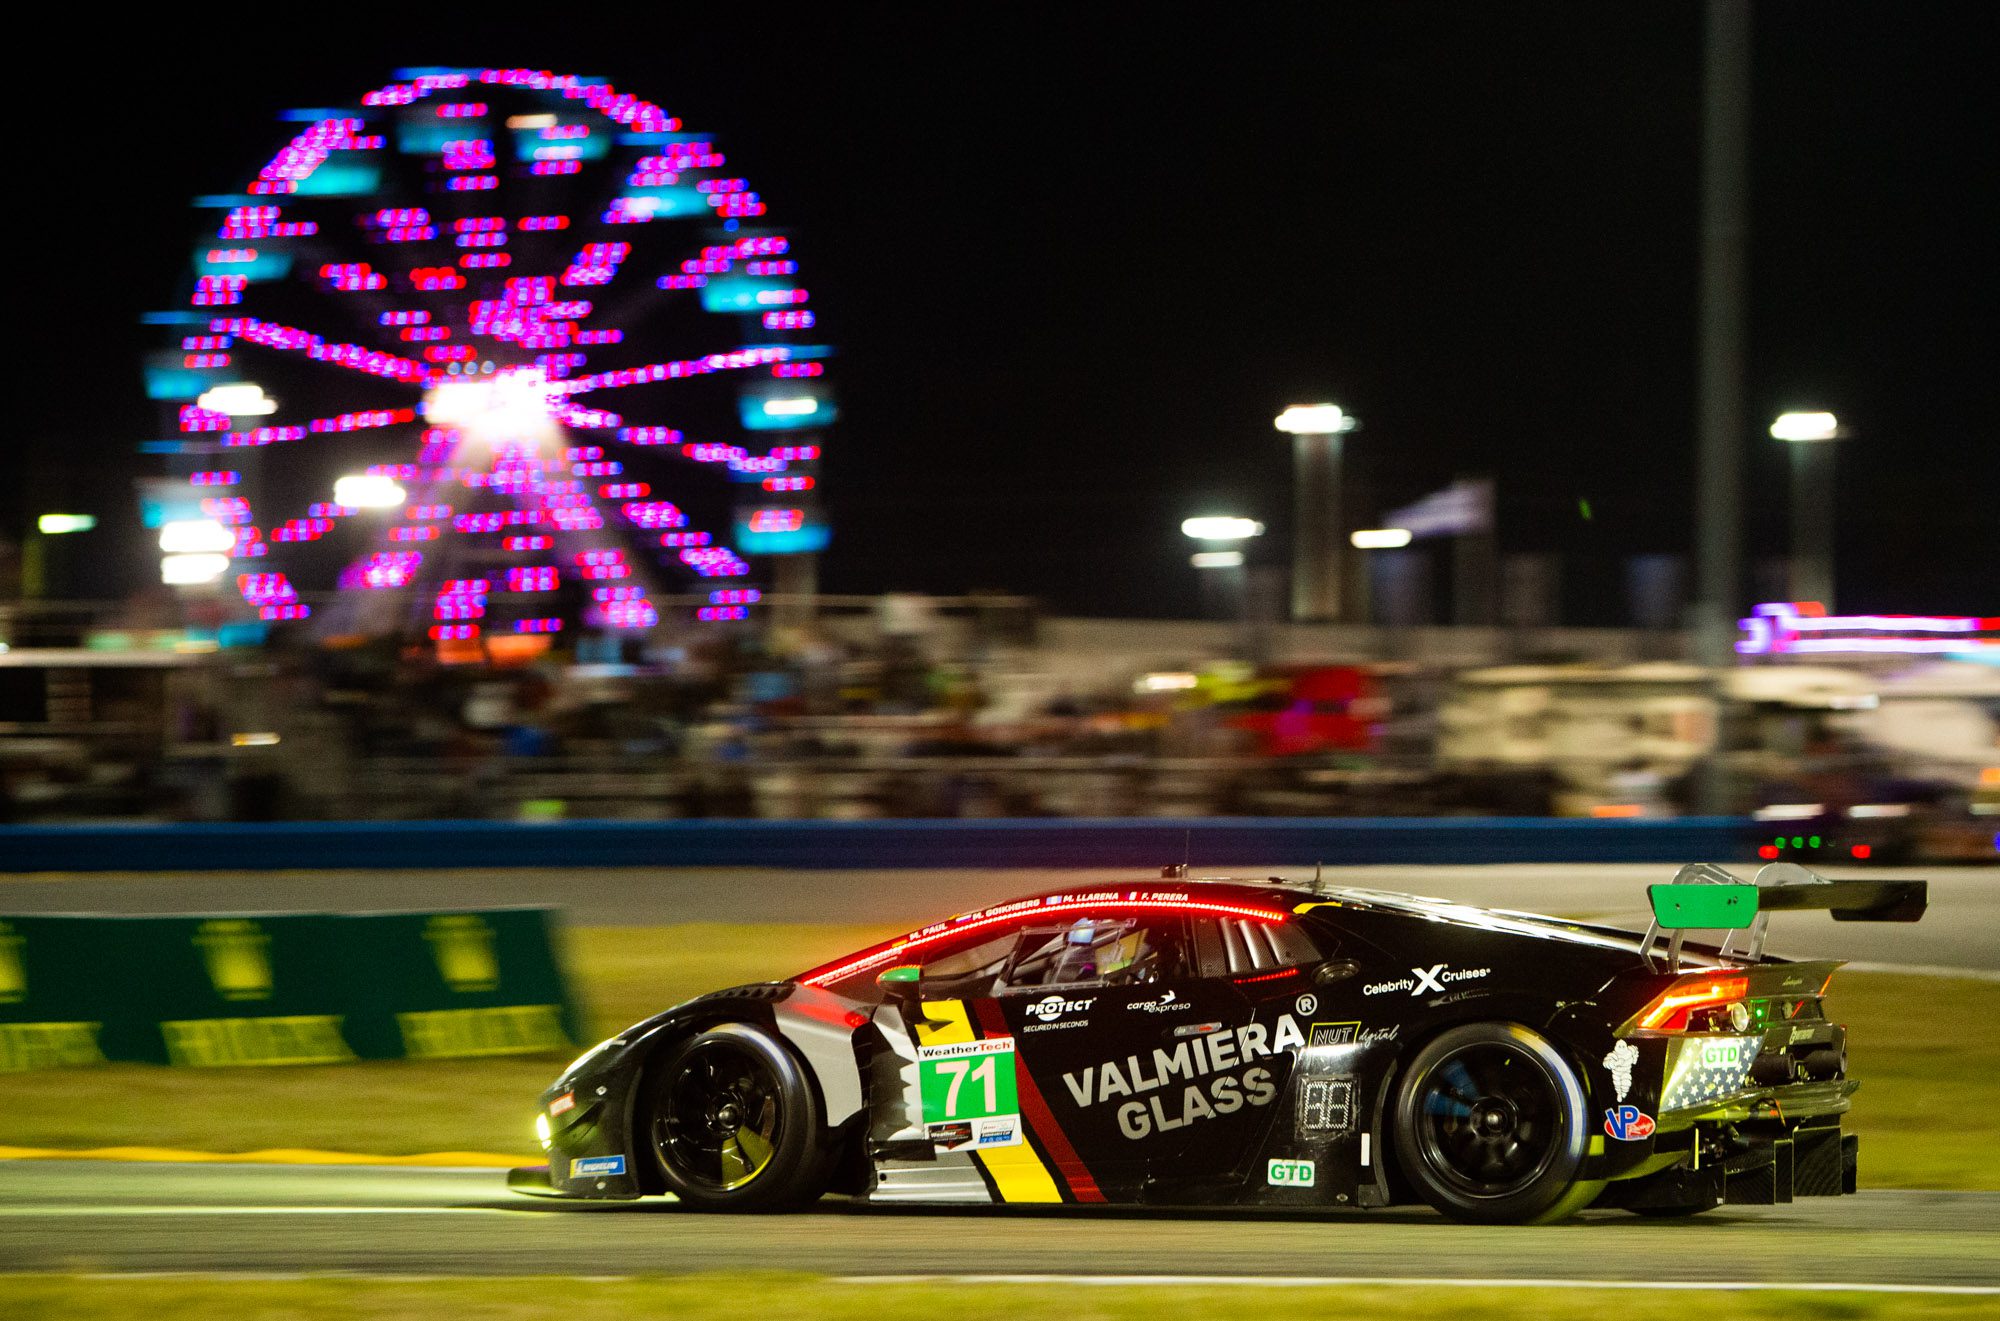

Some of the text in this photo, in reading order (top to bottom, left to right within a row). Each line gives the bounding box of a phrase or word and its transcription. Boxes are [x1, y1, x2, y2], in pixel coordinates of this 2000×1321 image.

[1062, 892, 1119, 903] M. LLARENA
[1151, 892, 1189, 901] PERERA
[922, 922, 948, 936] PAUL
[1363, 979, 1415, 996] Celebrity
[1441, 968, 1488, 982] Cruises
[1025, 999, 1094, 1016] PROTECT
[1127, 1000, 1191, 1014] cargo expreso
[1023, 1024, 1052, 1033] SECURED
[1060, 1019, 1089, 1030] SECONDS
[1313, 1024, 1400, 1049] NUT digital
[923, 1041, 1012, 1057] WeatherTech
[1704, 1047, 1738, 1063] GTD
[935, 1056, 997, 1117] 71
[1117, 1067, 1276, 1140] GLASS
[1605, 1105, 1640, 1140] VP
[1270, 1163, 1313, 1182] GTD
